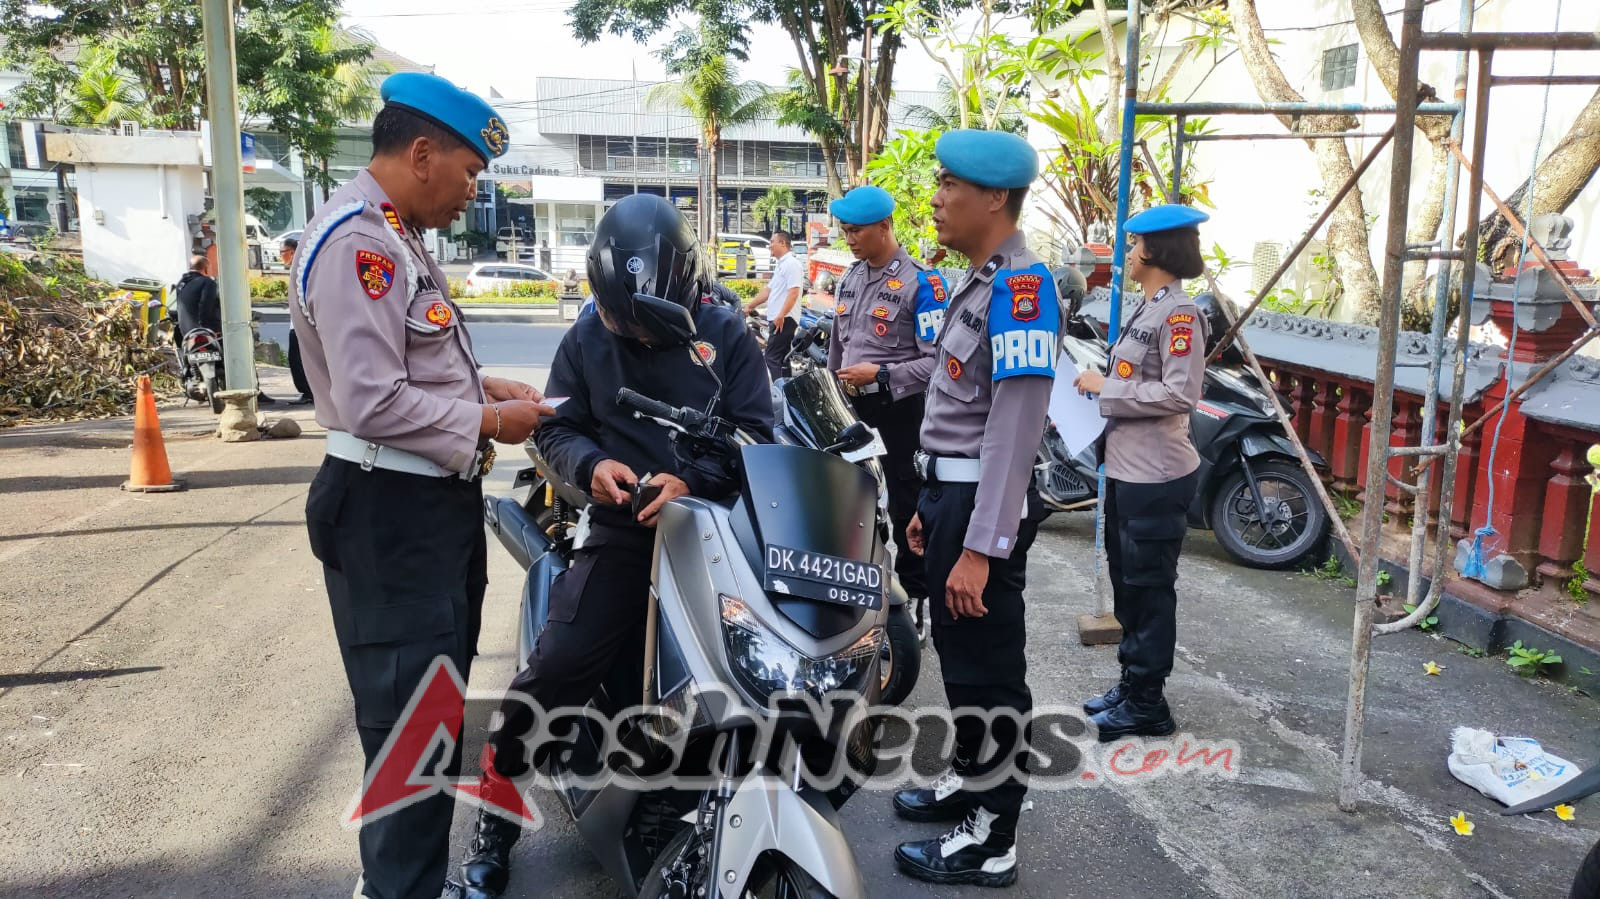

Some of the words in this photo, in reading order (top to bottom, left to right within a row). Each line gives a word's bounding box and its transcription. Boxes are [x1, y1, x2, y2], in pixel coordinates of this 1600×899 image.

[494, 164, 518, 175] Suku
[359, 250, 393, 270] PROPAM
[877, 292, 901, 305] POLRI
[960, 308, 983, 334] POLRI
[1196, 407, 1220, 421] HONDA
[768, 547, 795, 572] DK
